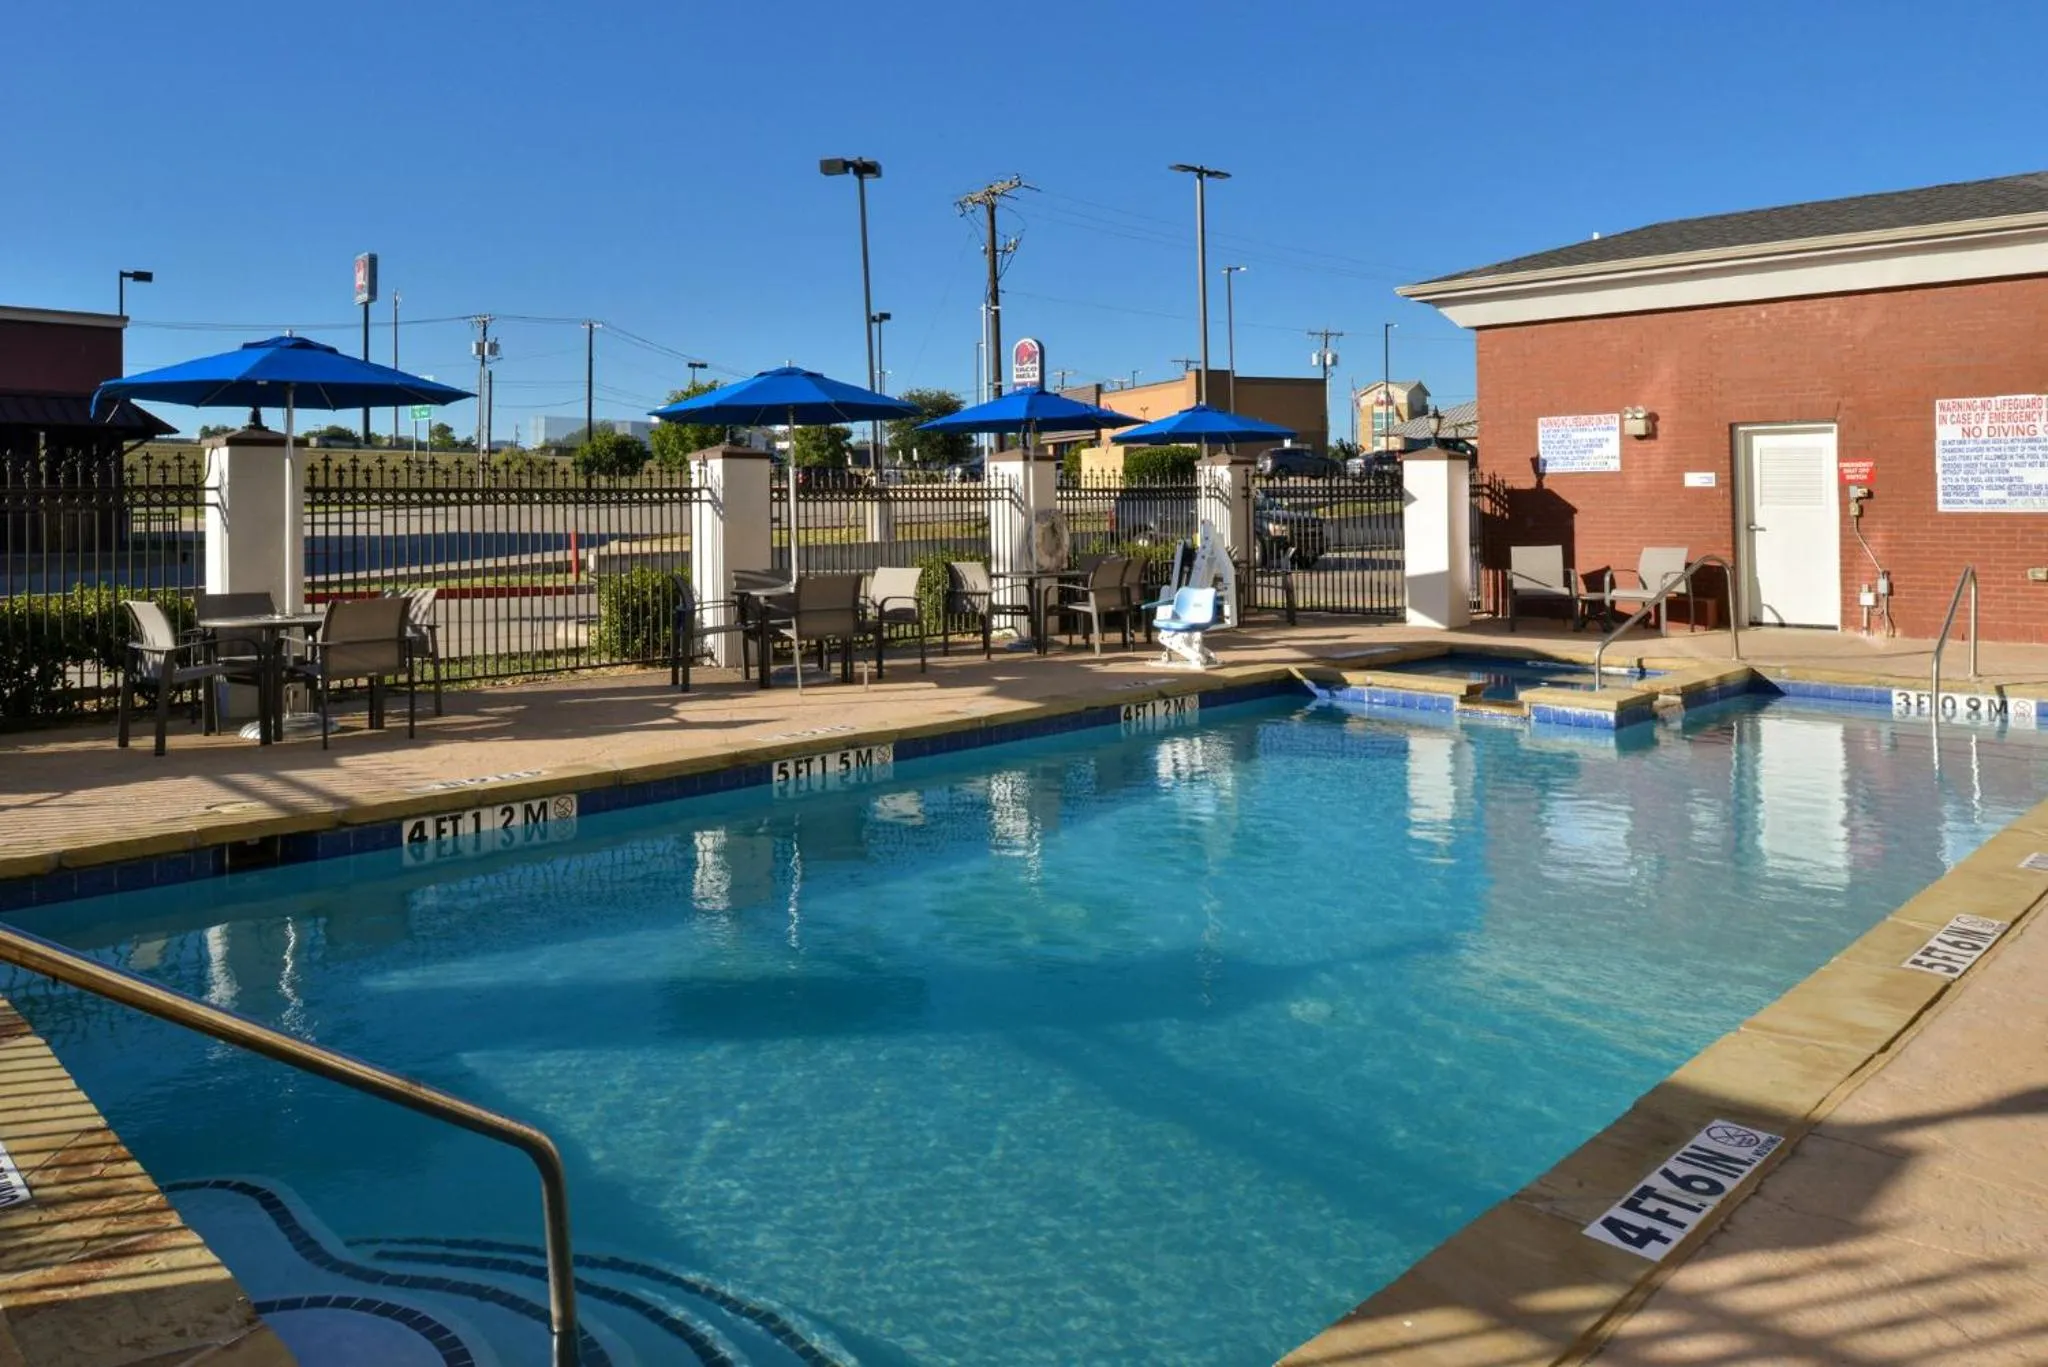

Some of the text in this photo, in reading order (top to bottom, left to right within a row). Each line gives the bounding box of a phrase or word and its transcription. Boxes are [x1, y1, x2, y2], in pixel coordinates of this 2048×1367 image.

[1995, 398, 2043, 411] LIFEGUARD
[1938, 411, 2043, 425] IN CASE OF EMERGENCY
[1962, 426, 1982, 438] NO
[1987, 424, 2038, 438] DIVING
